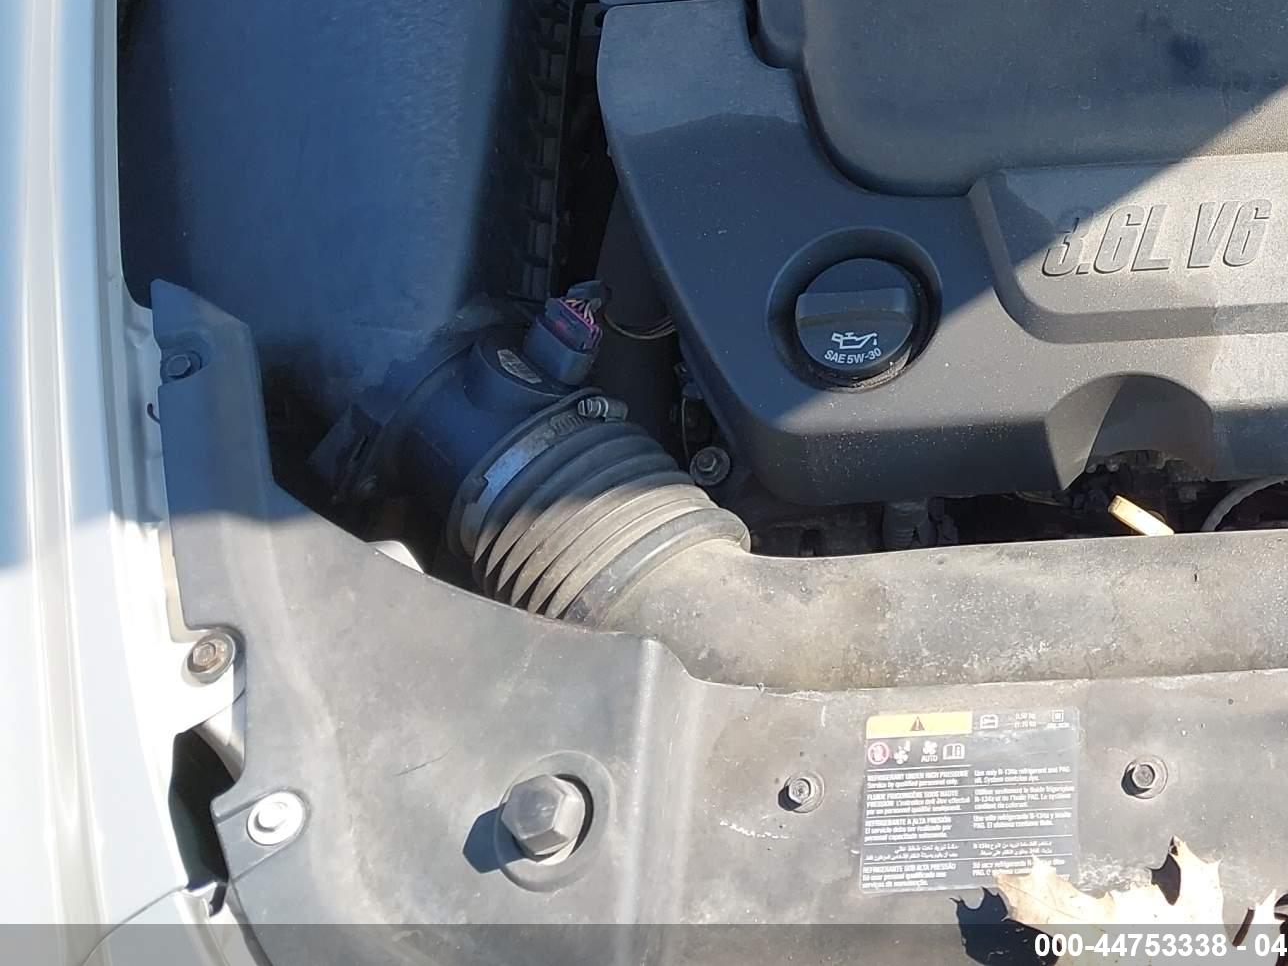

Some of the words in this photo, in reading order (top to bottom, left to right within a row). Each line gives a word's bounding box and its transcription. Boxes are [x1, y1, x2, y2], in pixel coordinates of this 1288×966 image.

[1041, 204, 1170, 277] 3.6L
[1187, 198, 1273, 269] V6
[824, 349, 846, 364] SAE
[846, 347, 882, 364] 5W-30
